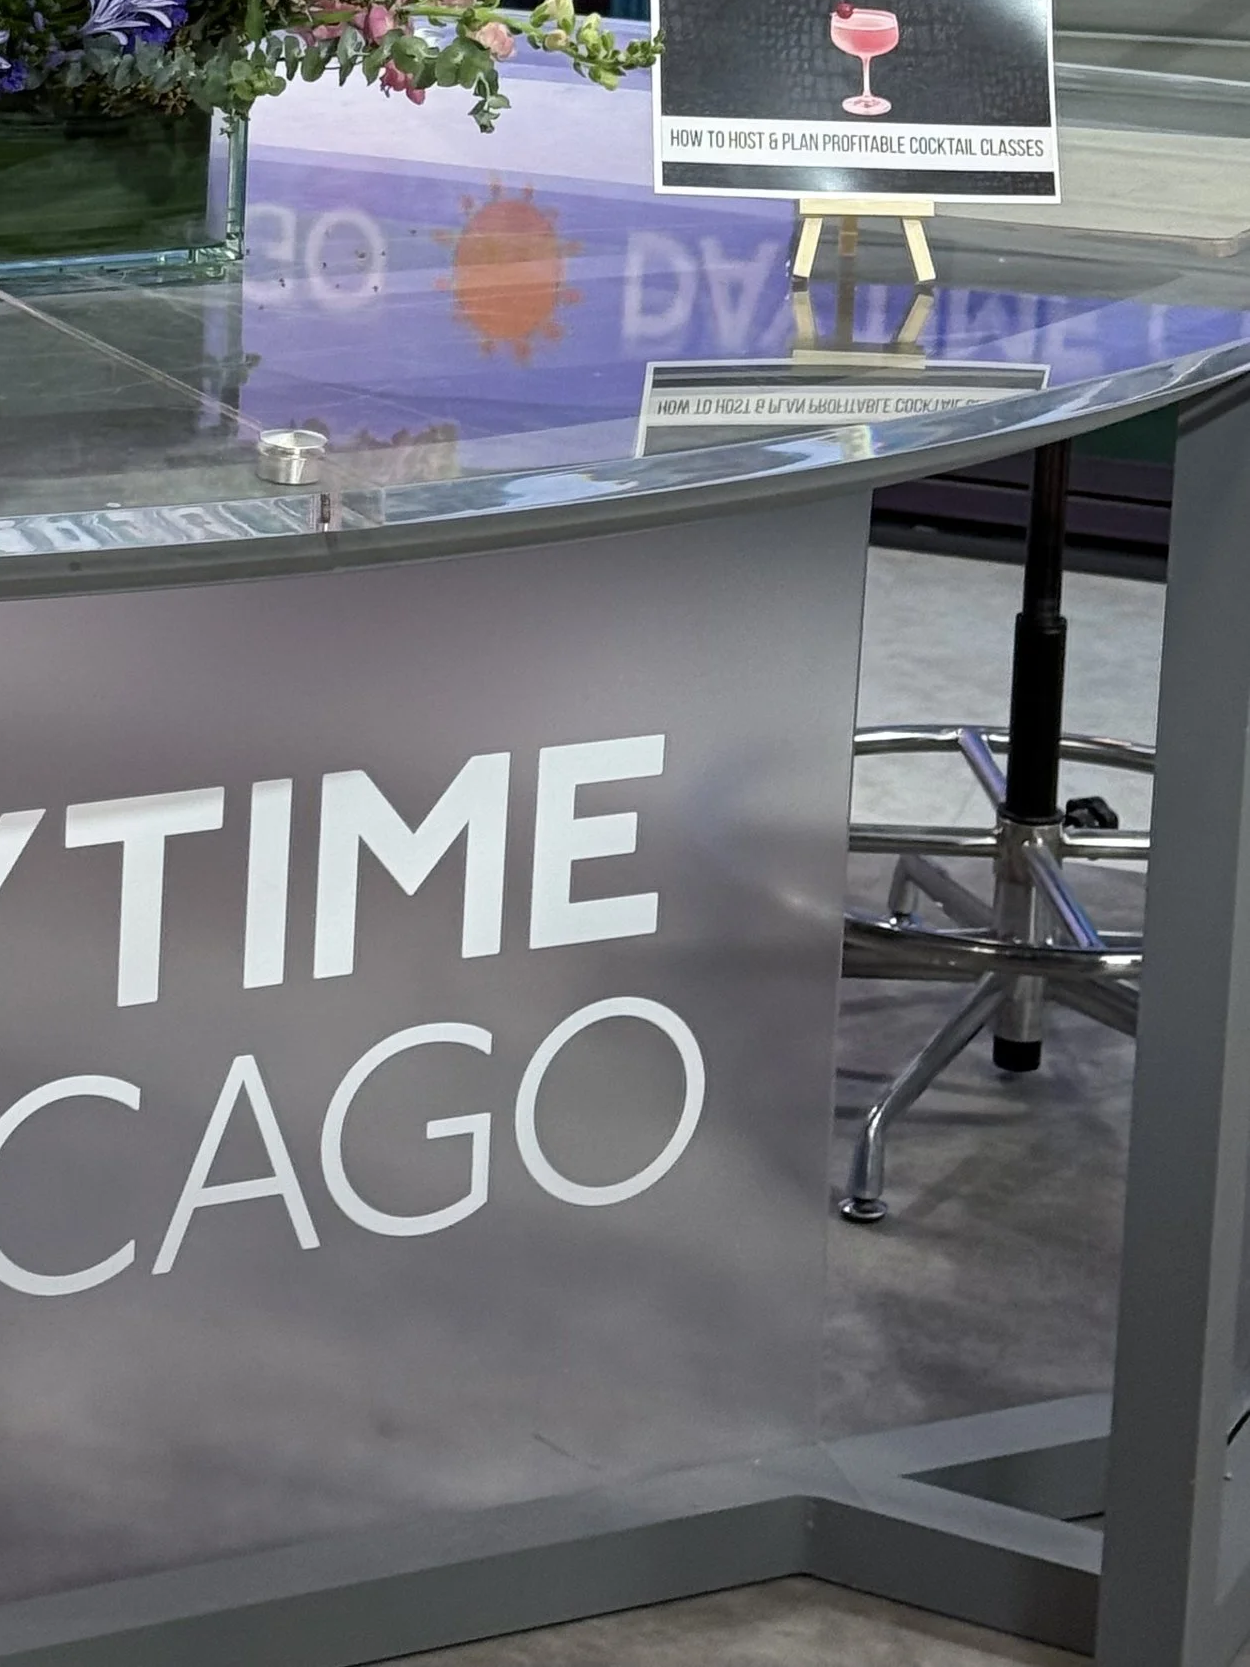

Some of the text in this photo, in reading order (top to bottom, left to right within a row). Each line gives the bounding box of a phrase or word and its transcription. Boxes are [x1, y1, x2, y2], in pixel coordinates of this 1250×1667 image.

[670, 129, 1045, 158] HOW TO HOST & PLAN PROFITABLE COCKTAIL CLASSES
